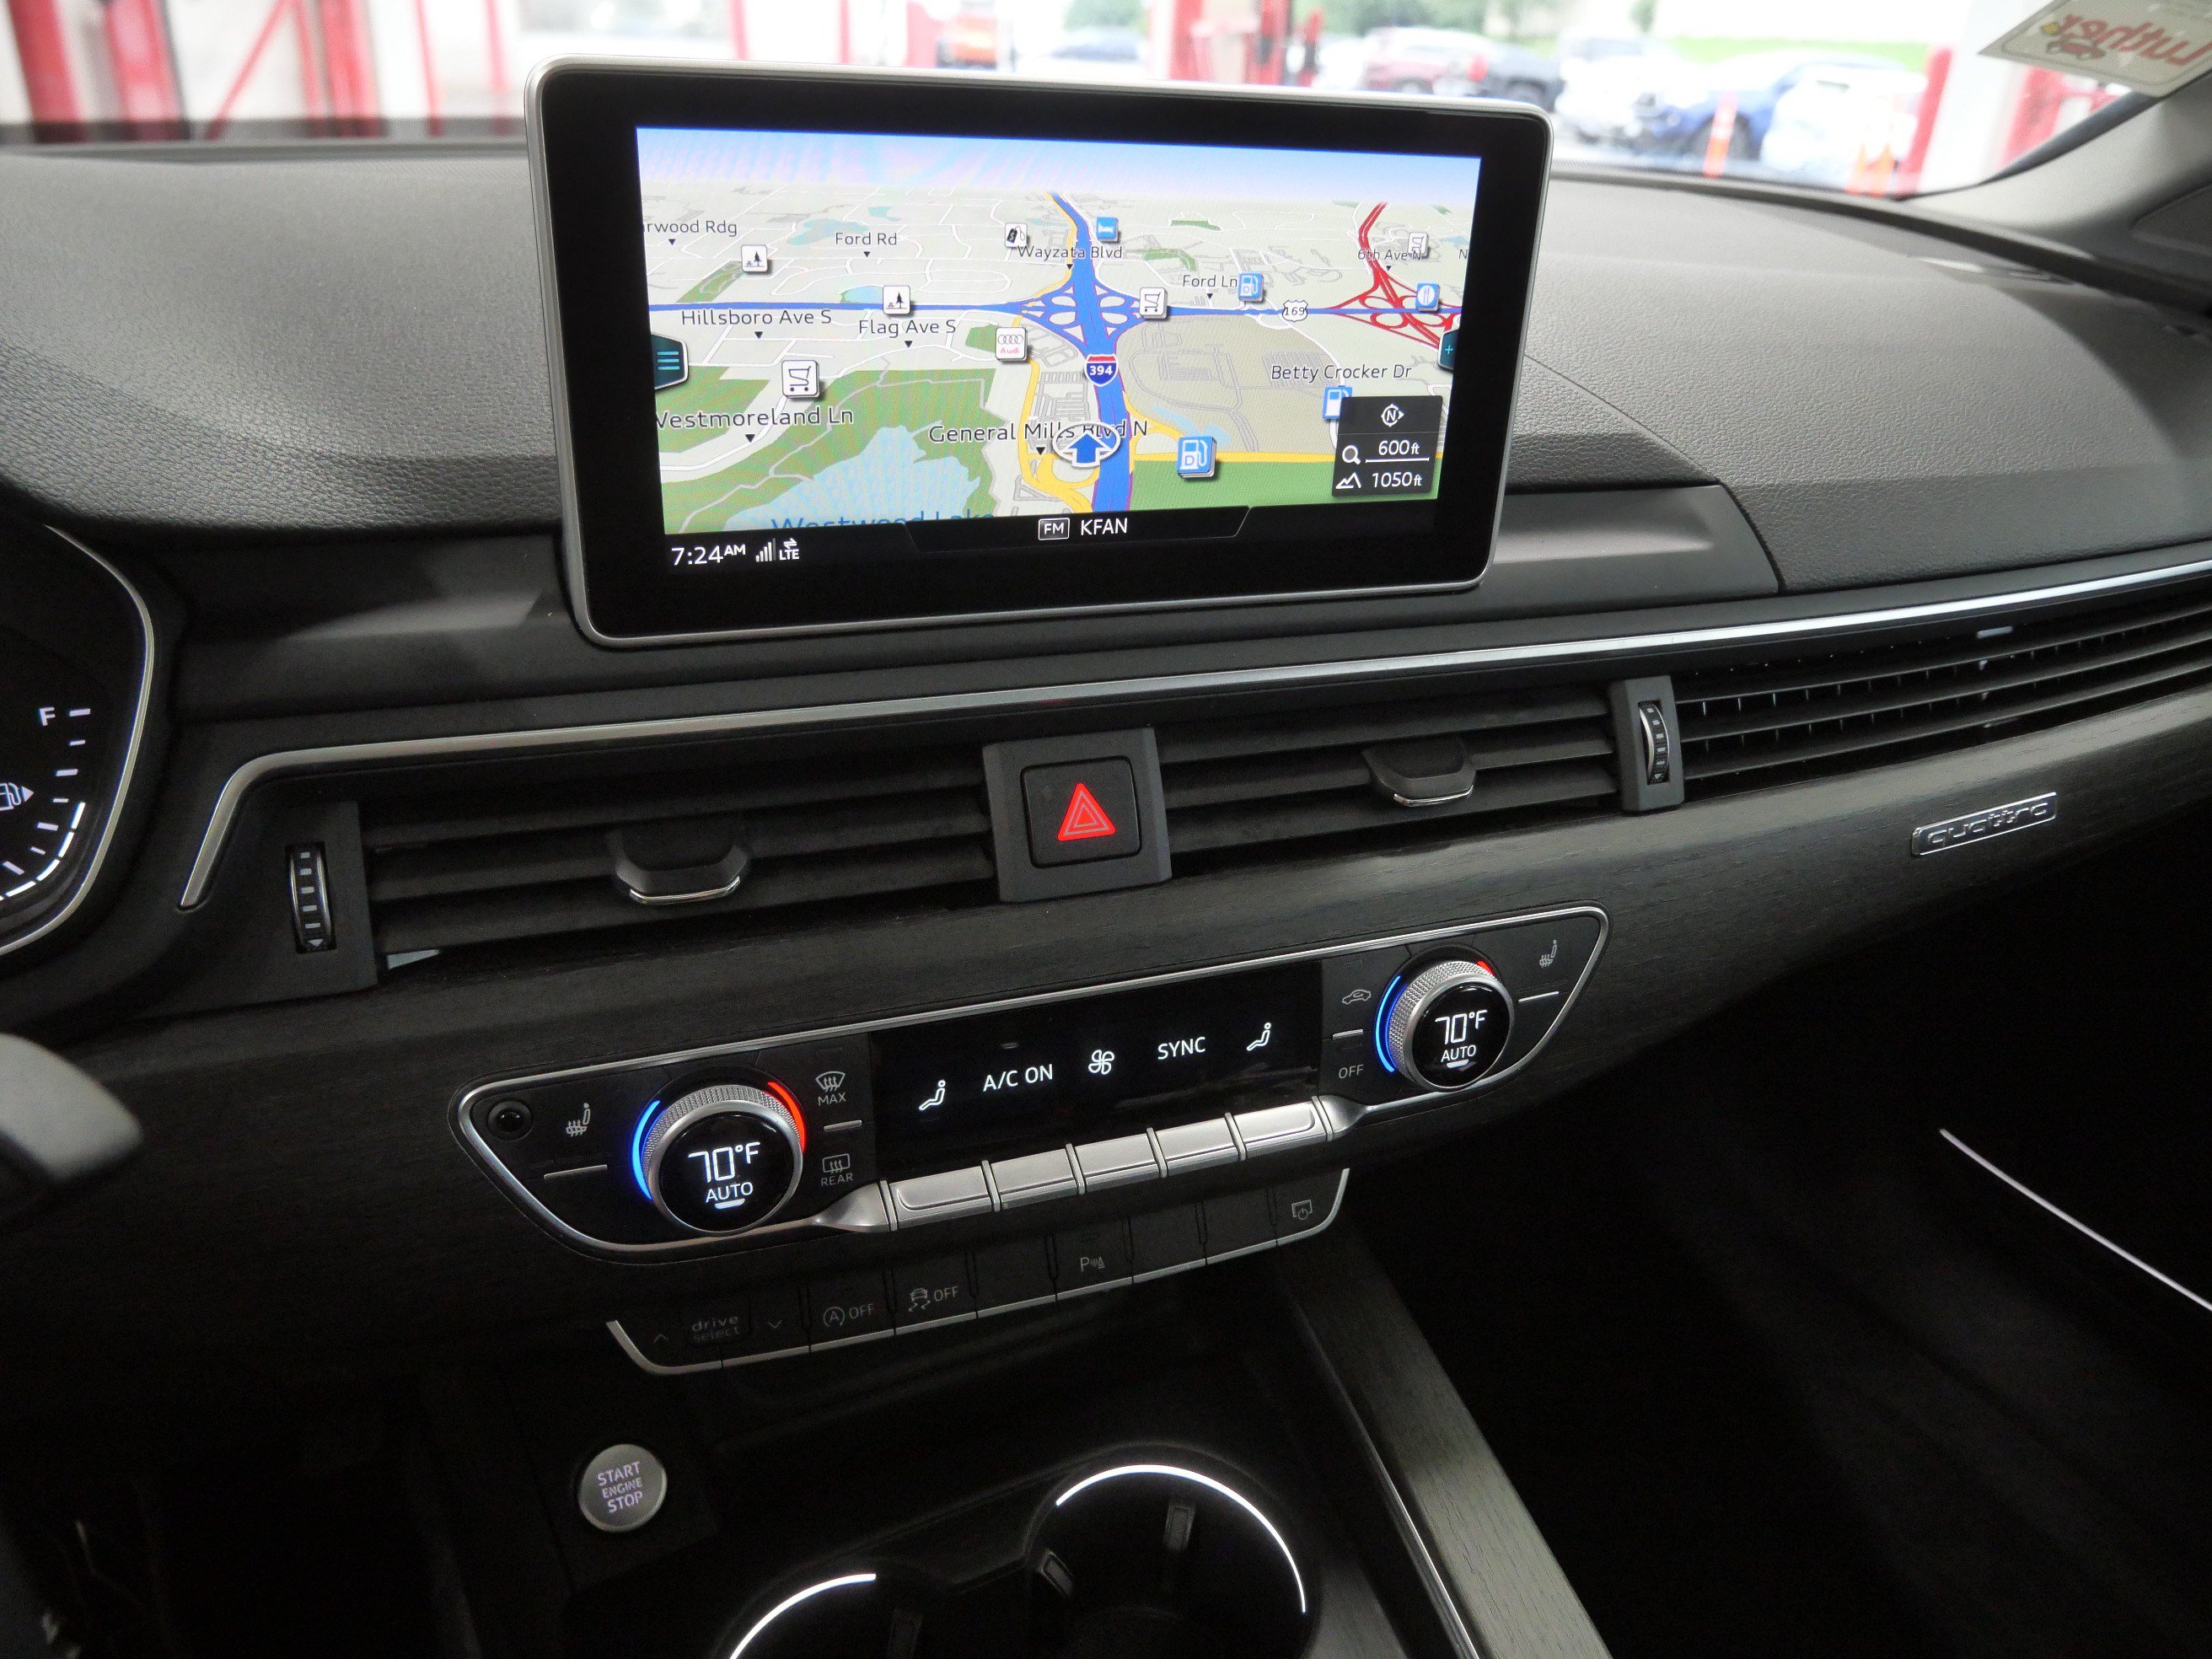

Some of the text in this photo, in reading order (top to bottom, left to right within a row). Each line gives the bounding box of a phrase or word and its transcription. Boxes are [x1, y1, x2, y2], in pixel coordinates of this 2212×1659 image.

[646, 219, 738, 238] rwood Rdg
[835, 232, 897, 245] Ford Rd
[1017, 245, 1123, 260] Wayzata Blvd
[1357, 249, 1380, 260] 6th
[1383, 249, 1408, 260] Ave
[1182, 275, 1238, 287] Ford Ln
[681, 309, 832, 325] Hillsboro Ave S
[1284, 307, 1305, 317] 169
[858, 319, 957, 336] Flag Ave S
[1089, 365, 1114, 376] 394
[1271, 363, 1413, 384] Betty Crocker Dr
[829, 406, 854, 424] Ln
[928, 421, 1017, 443] General
[1133, 420, 1148, 437] N
[1044, 518, 1128, 536] FM KFAN
[779, 549, 800, 561] LTE
[39, 706, 56, 727] F
[1434, 1009, 1489, 1045] 70°F
[1441, 1044, 1477, 1063] AUTO
[982, 1035, 1207, 1093] A/C ON SYNC
[1338, 1065, 1365, 1080] OFF
[817, 1091, 847, 1106] MAX
[686, 1141, 761, 1184] 70°F
[820, 1172, 854, 1188] REAR
[704, 1181, 754, 1205] AUTO
[933, 1286, 960, 1303] OFF
[848, 1303, 876, 1320] OFF
[691, 1315, 739, 1333] drive
[596, 1460, 641, 1487] START
[601, 1476, 644, 1500] ENGINE
[606, 1490, 644, 1514] STOP
